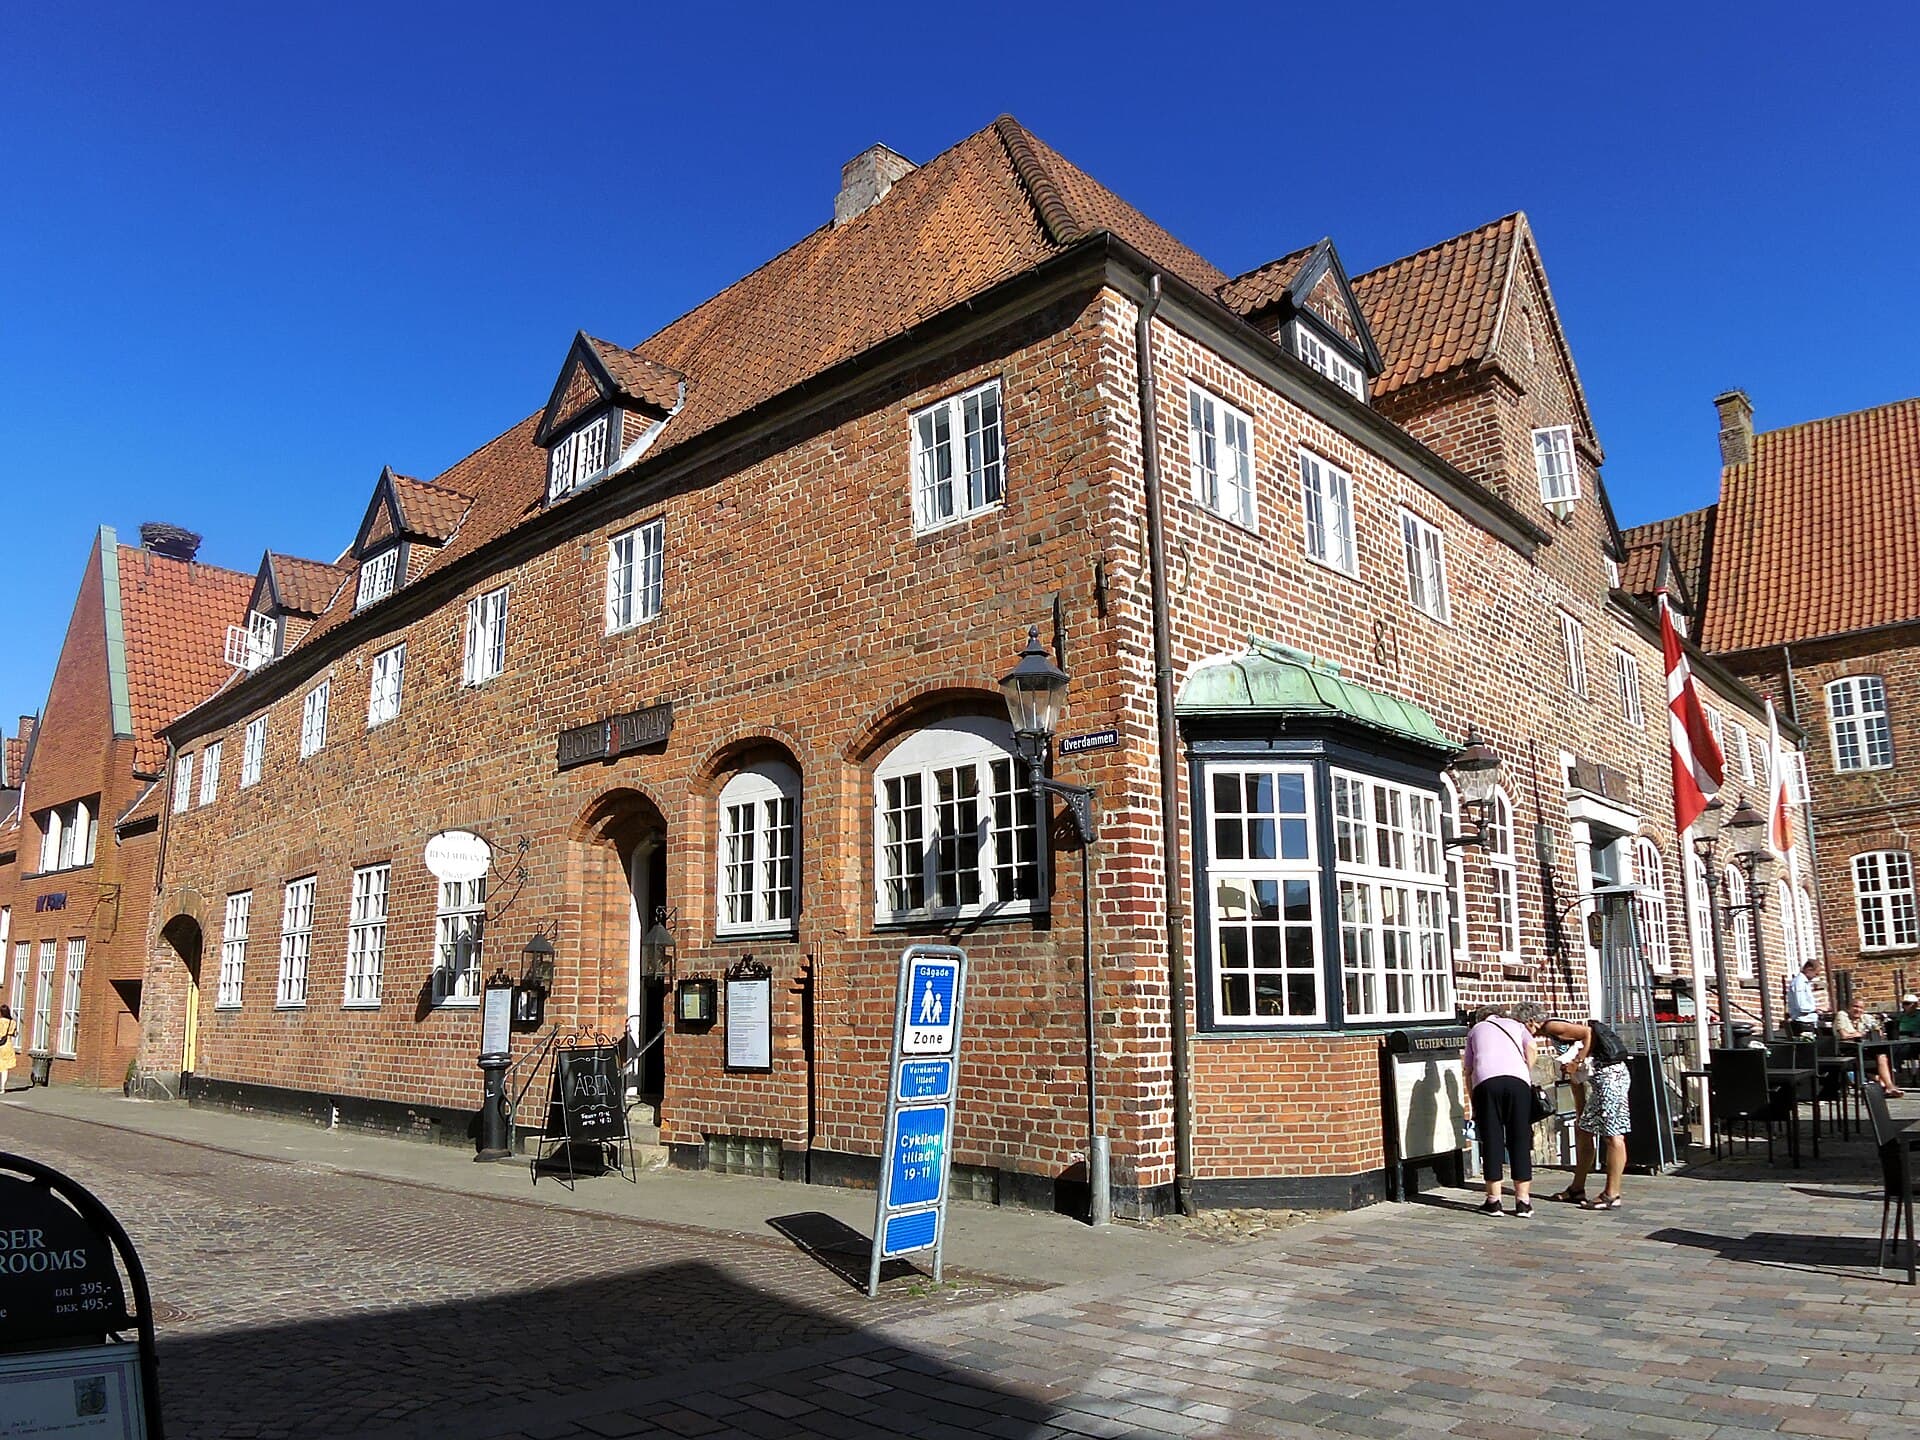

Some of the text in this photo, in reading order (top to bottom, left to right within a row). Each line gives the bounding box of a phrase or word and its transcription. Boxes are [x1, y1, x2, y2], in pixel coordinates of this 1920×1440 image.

[1064, 734, 1114, 751] Overdammen
[920, 966, 949, 978] Gågade
[913, 1032, 943, 1045] Zone
[901, 1133, 940, 1149] Cykling
[902, 1150, 935, 1165] tilladt
[903, 1166, 930, 1181] 19-11
